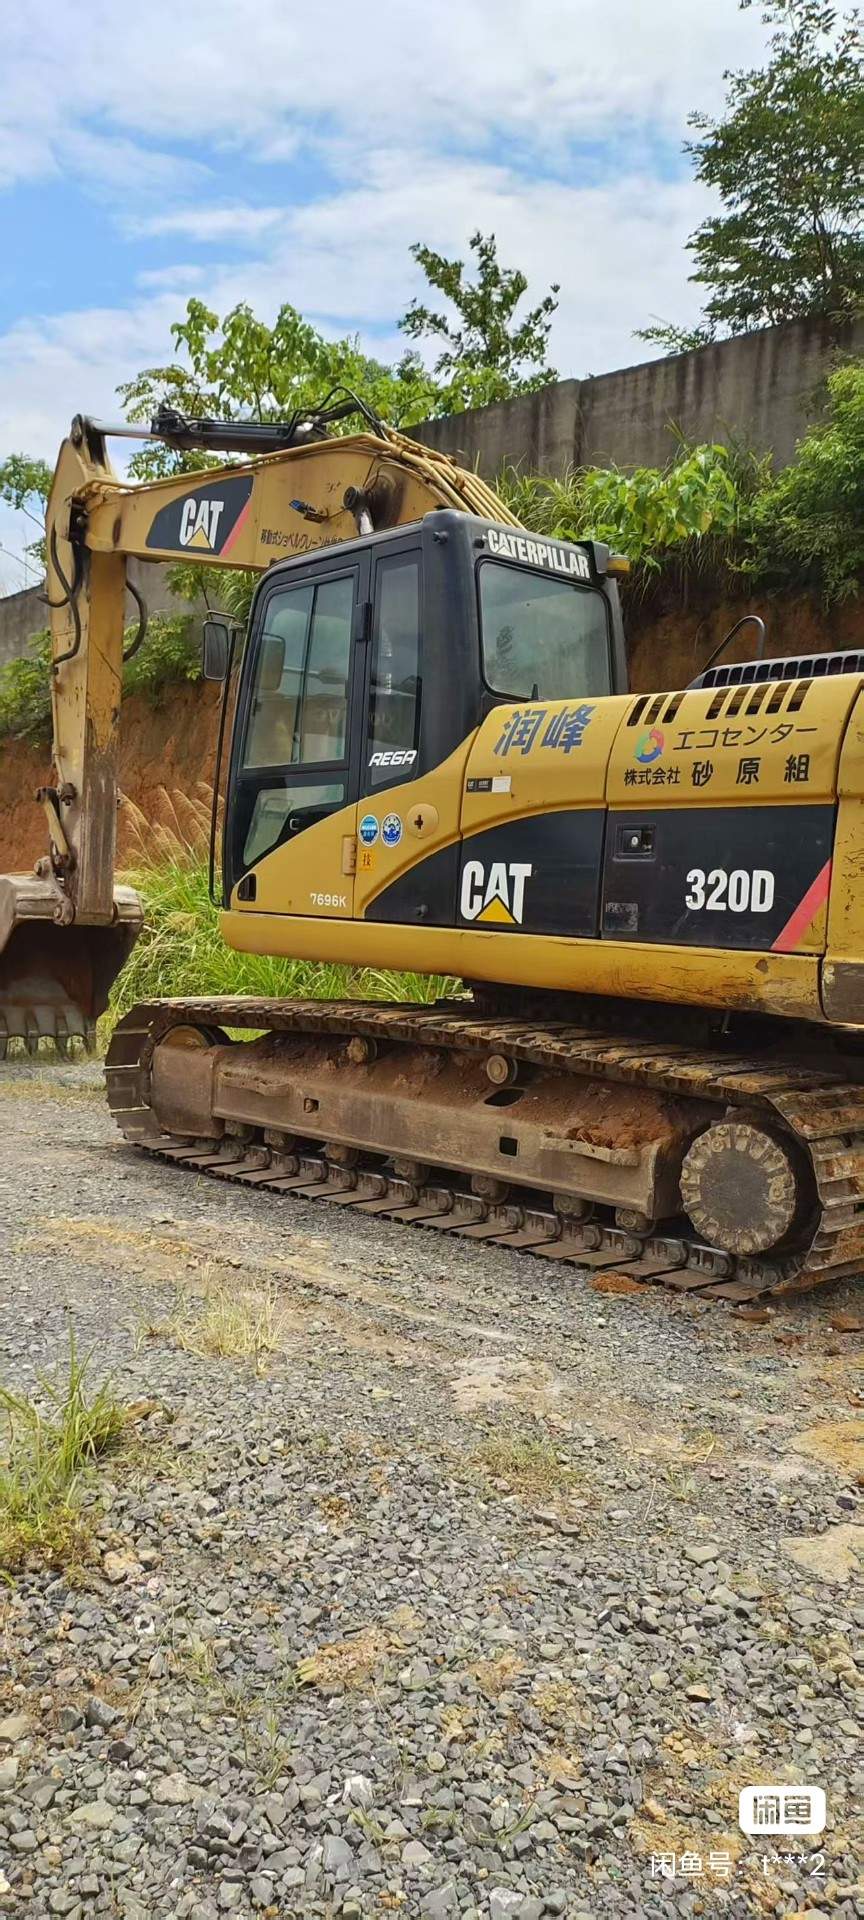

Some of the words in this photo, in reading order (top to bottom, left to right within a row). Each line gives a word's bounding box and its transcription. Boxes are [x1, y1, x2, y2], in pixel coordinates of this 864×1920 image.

[179, 498, 225, 549] CAT
[487, 529, 591, 579] CATERPILLAR
[493, 703, 597, 757] 润峰
[673, 723, 818, 751] エコセンター
[368, 750, 418, 767] REGA
[624, 767, 681, 787] 株式会社
[310, 892, 347, 908] 7696K
[460, 860, 533, 925] CAT
[685, 868, 776, 913] 320D
